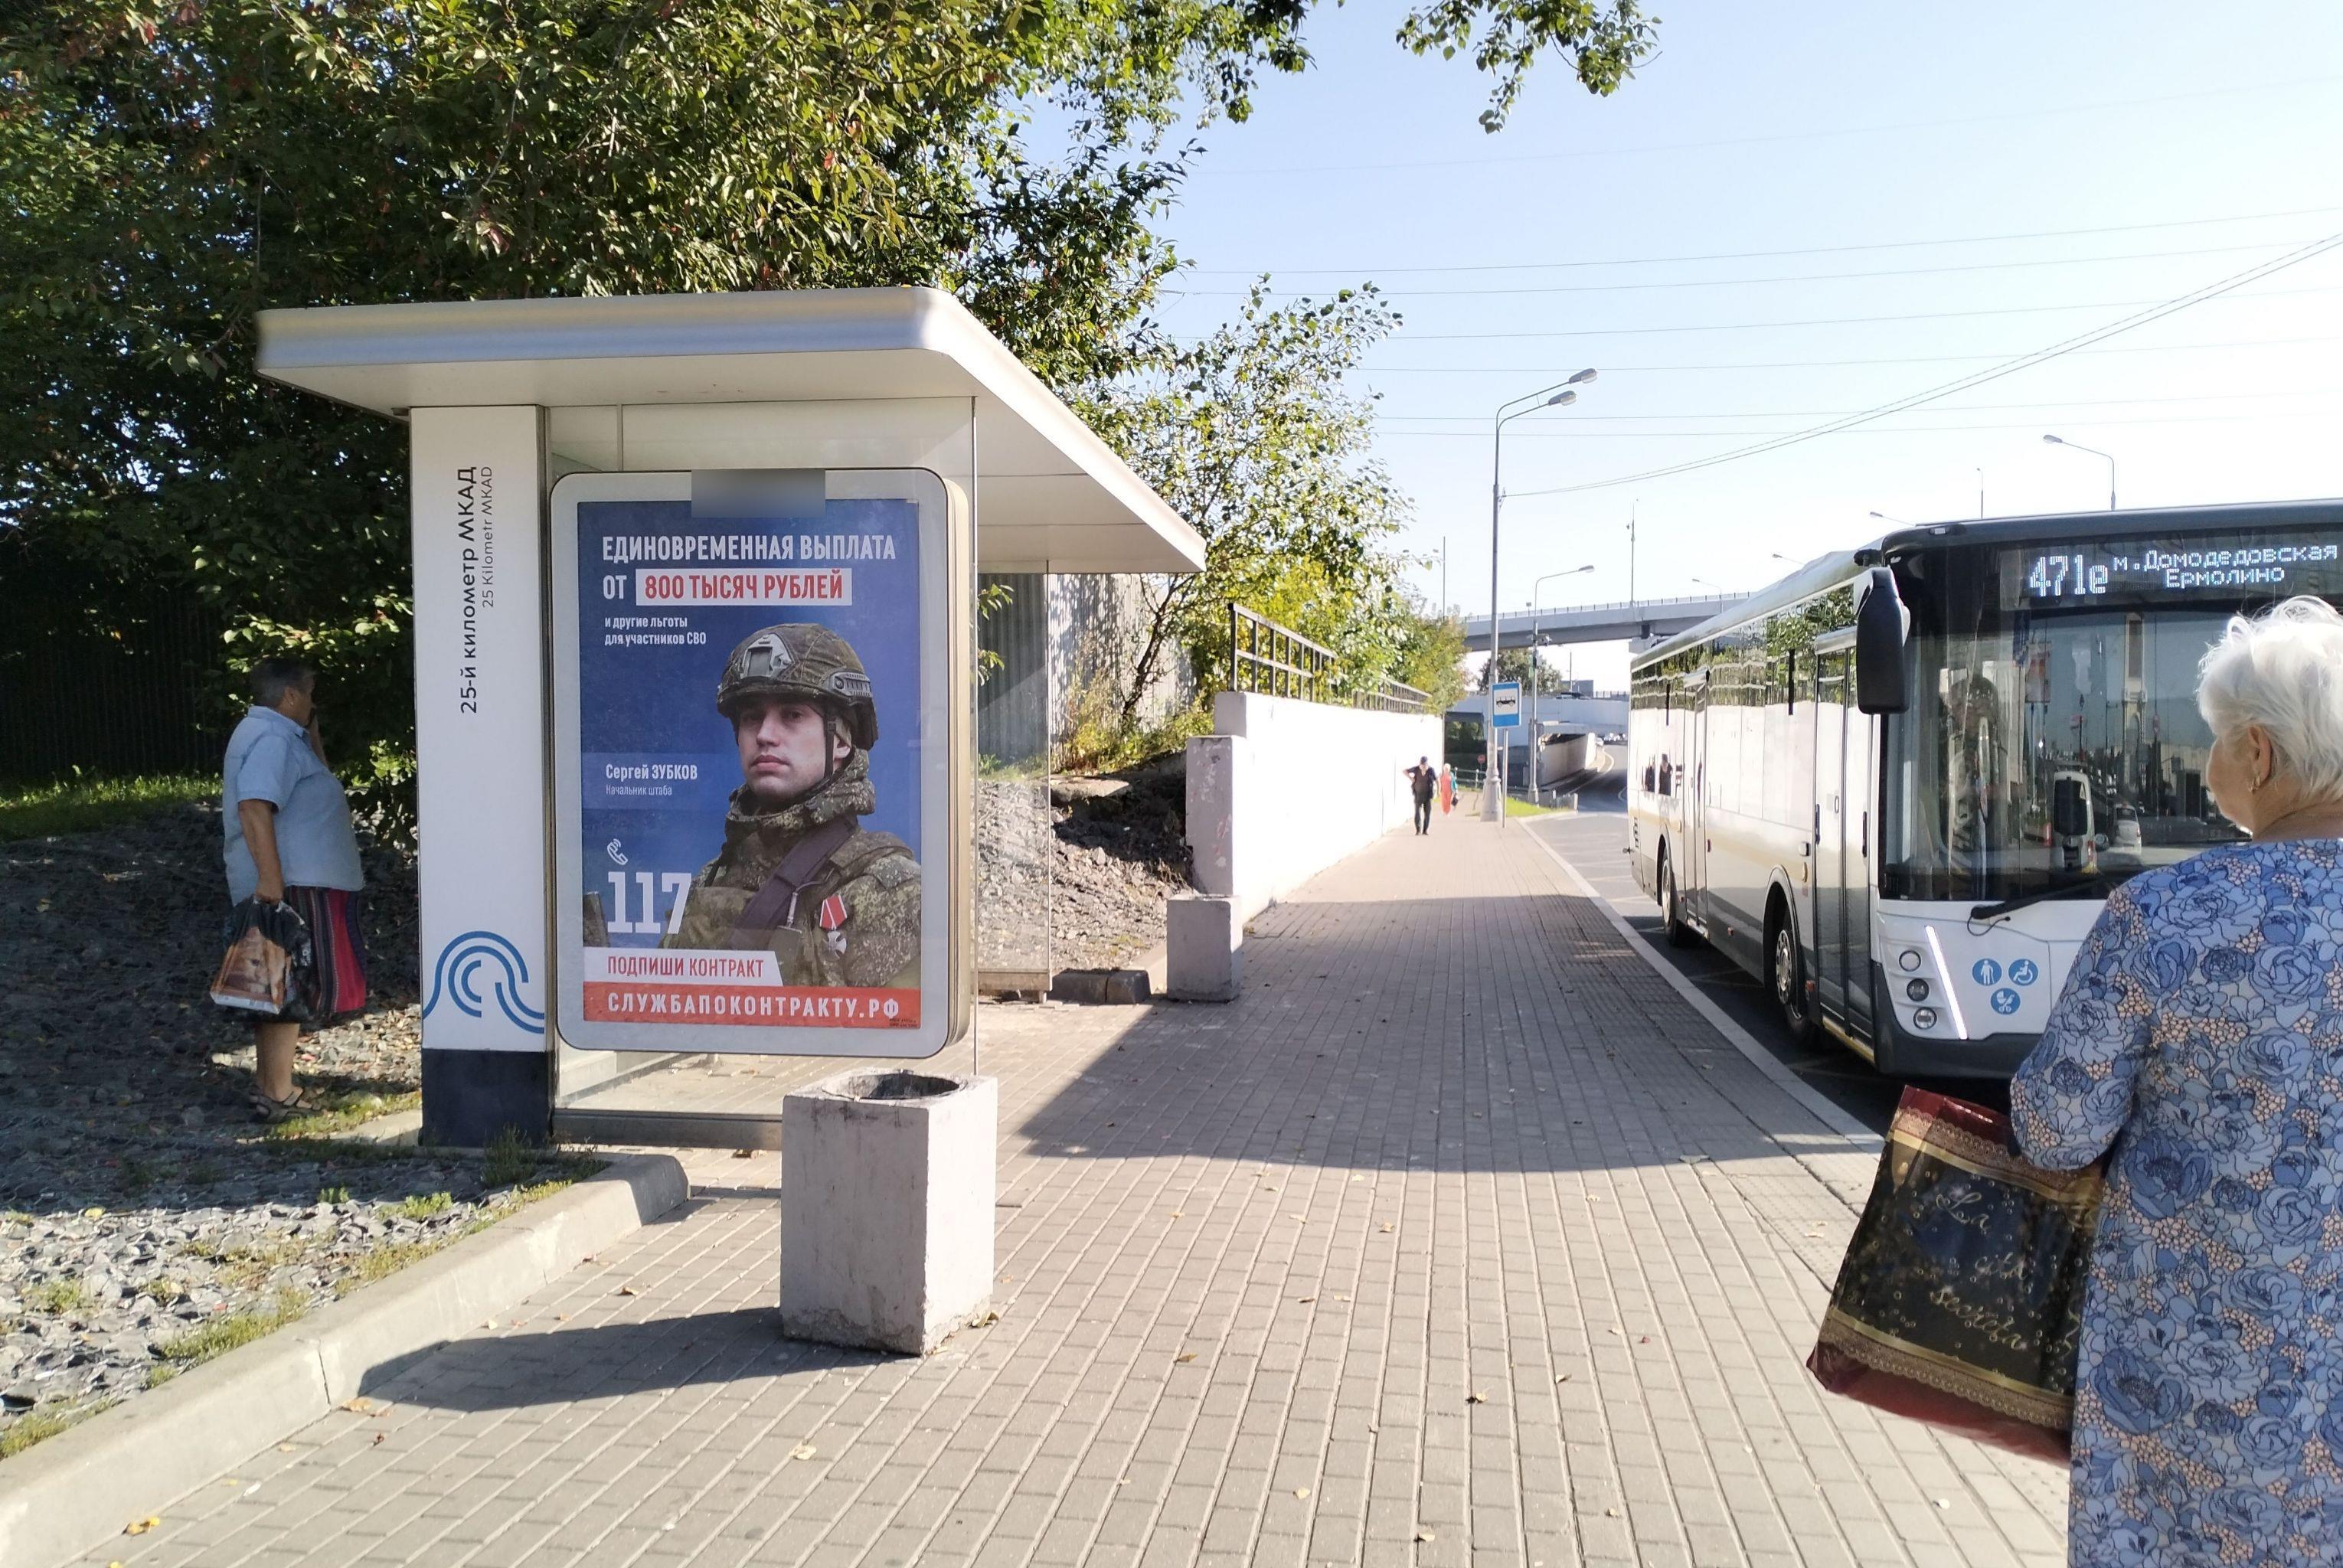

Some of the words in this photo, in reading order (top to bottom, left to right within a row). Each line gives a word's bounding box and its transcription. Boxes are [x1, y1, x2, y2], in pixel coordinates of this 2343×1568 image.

[457, 466, 477, 542] МКАД
[481, 466, 493, 515] MKAD
[481, 518, 494, 586] Kilometr
[603, 535, 793, 564] ЕДИНОВРЕМЕННАЯ
[800, 535, 896, 560] ВЫПЛАТА
[603, 574, 627, 599] ОТ
[645, 575, 684, 599] 800
[689, 575, 757, 599] ТЫСЯЧ
[764, 569, 843, 599] РУБЛЕЙ
[2166, 567, 2286, 590] Ермолино
[462, 548, 479, 658] километр
[482, 590, 495, 608] 25
[604, 617, 611, 628] и
[613, 617, 649, 630] другие
[650, 617, 688, 628] льготы
[604, 634, 623, 646] для
[625, 634, 685, 648] участников
[686, 632, 707, 645] СВО
[459, 667, 477, 714] 25-й
[606, 763, 649, 782] Сергей
[652, 764, 698, 780] ЗУБКОВ
[606, 784, 647, 796] Начальник
[648, 785, 672, 796] штаба
[607, 871, 692, 935] 117
[608, 955, 685, 978] ПОДПИШИ
[690, 957, 764, 978] КОНТРАКТ
[607, 991, 900, 1019] СЛУЖБАПОКОНТРАКТУ.РФ
